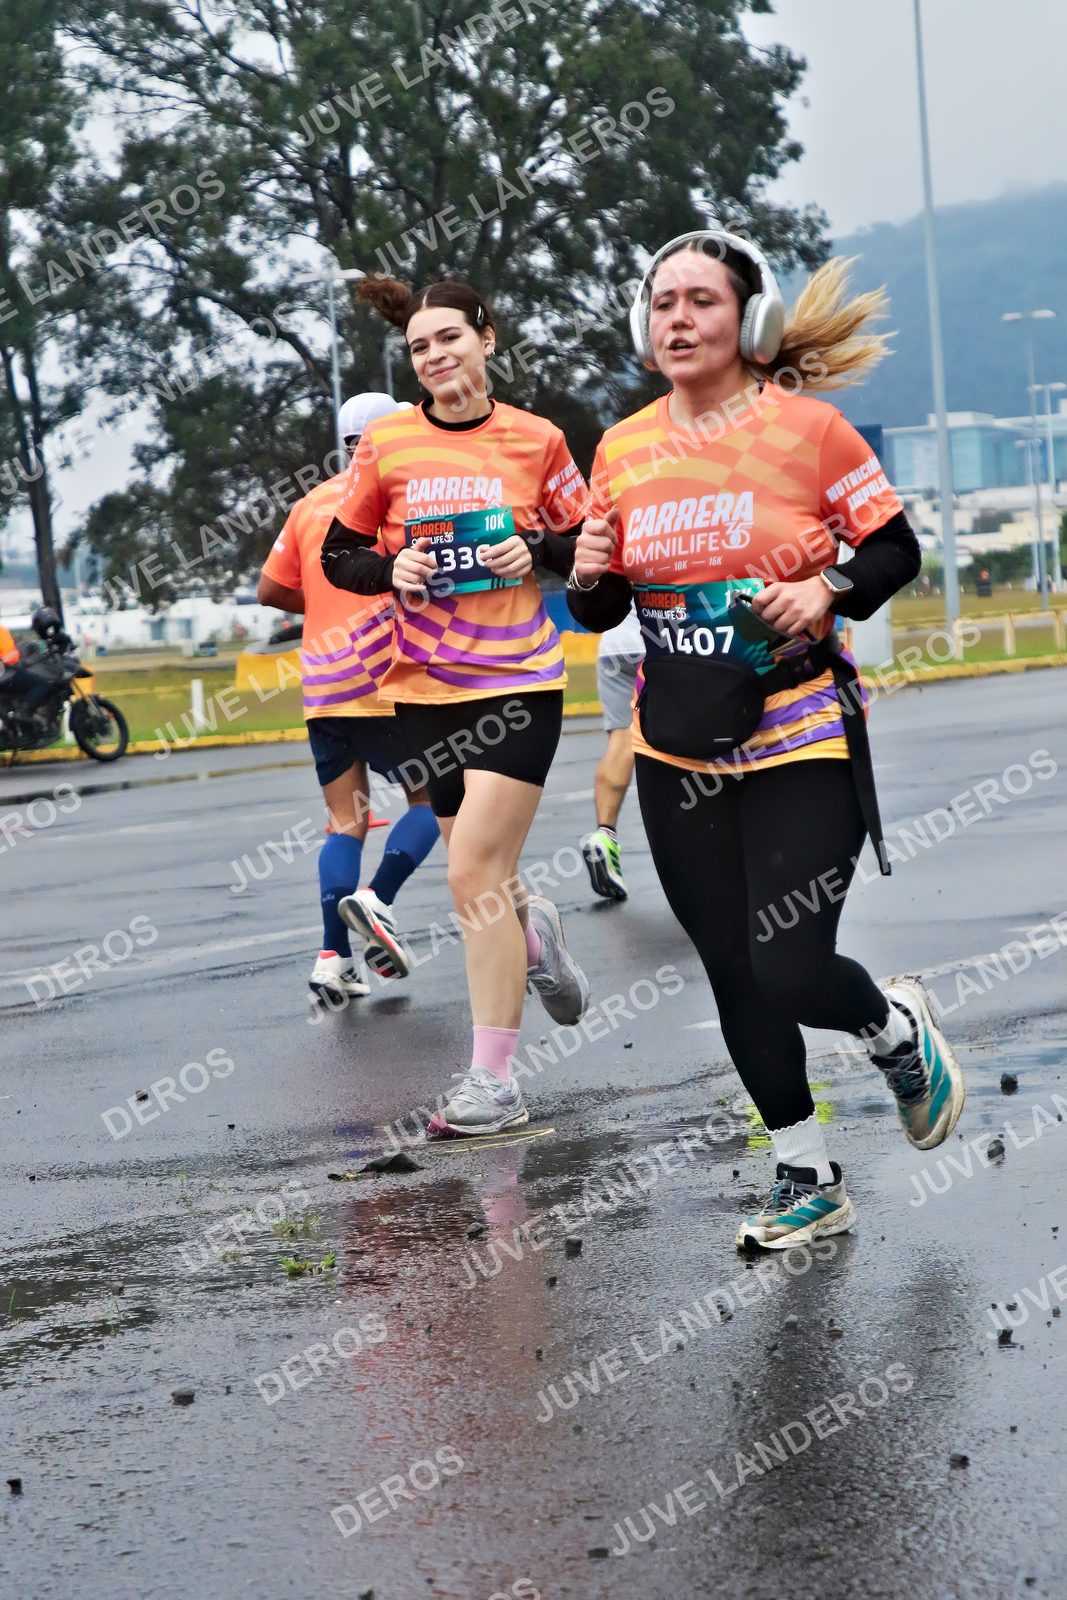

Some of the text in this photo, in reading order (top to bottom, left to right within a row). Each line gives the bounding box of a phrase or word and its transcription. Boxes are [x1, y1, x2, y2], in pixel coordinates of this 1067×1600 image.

[406, 476, 503, 504] CARRERA
[484, 513, 505, 531] 10K
[626, 491, 754, 542] CARRERA
[411, 521, 453, 537] CARRERA
[624, 531, 720, 567] OMNILIFE
[674, 560, 688, 571] 10K
[639, 592, 686, 609] CARRERA
[660, 626, 735, 656] 1407
